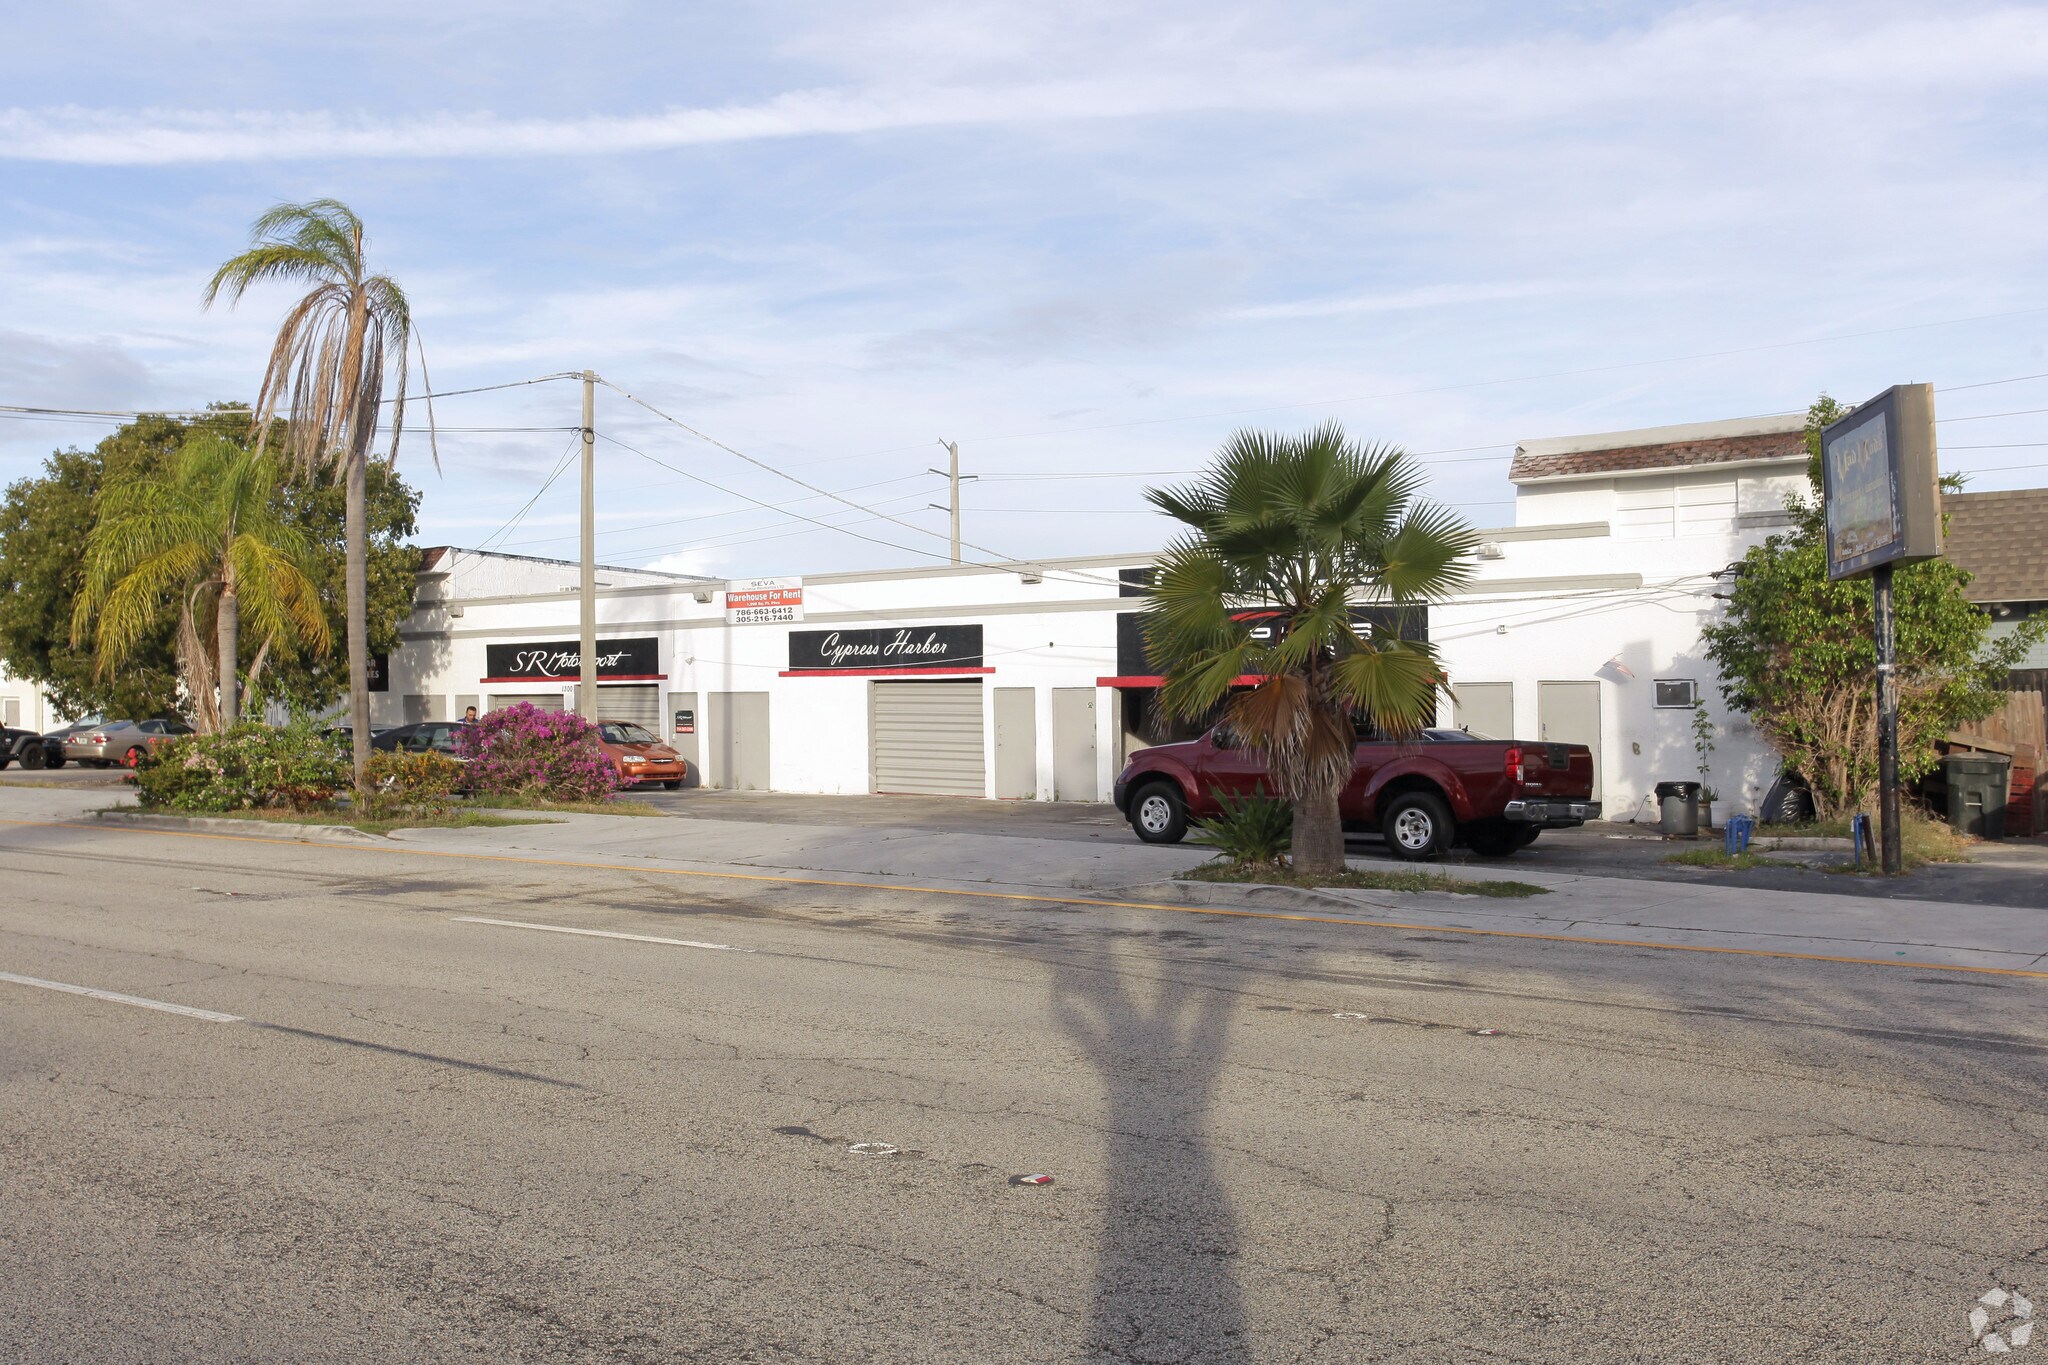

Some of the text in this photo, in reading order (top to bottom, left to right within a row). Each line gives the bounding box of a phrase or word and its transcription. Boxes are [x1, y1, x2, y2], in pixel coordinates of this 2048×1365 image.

[728, 590, 801, 602] Warehouse For Rent
[736, 607, 793, 616] 786-663-6412
[736, 614, 794, 623] 305-216-7440
[821, 629, 948, 665] Cypress Harbor
[562, 685, 574, 693] 1300
